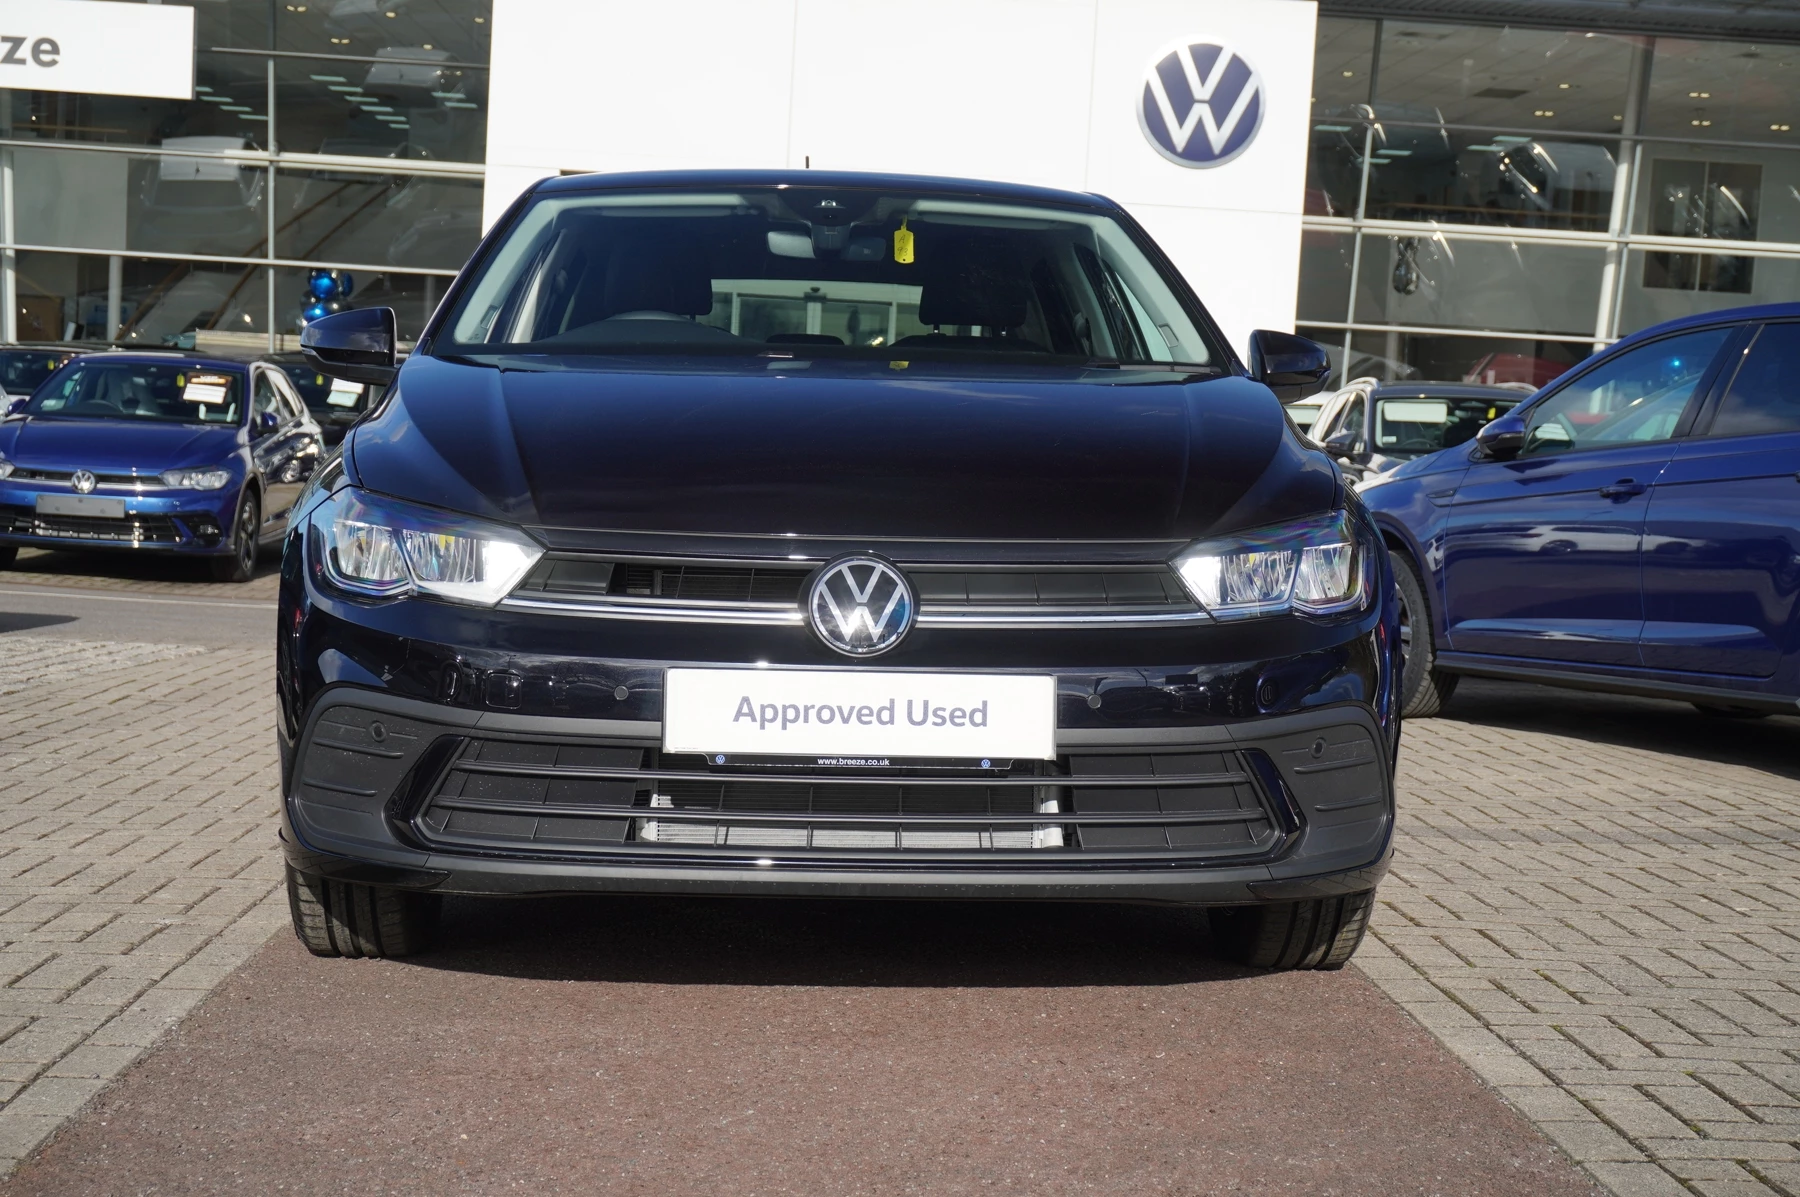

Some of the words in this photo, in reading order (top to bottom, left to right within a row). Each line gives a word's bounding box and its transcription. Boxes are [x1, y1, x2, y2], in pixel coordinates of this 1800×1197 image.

[1139, 40, 1262, 161] VW
[899, 234, 906, 244] A
[897, 247, 909, 256] 93
[812, 559, 910, 652] VW
[732, 695, 896, 731] Approved
[906, 699, 988, 728] Used
[817, 758, 890, 766] www.breeze.co.uk
